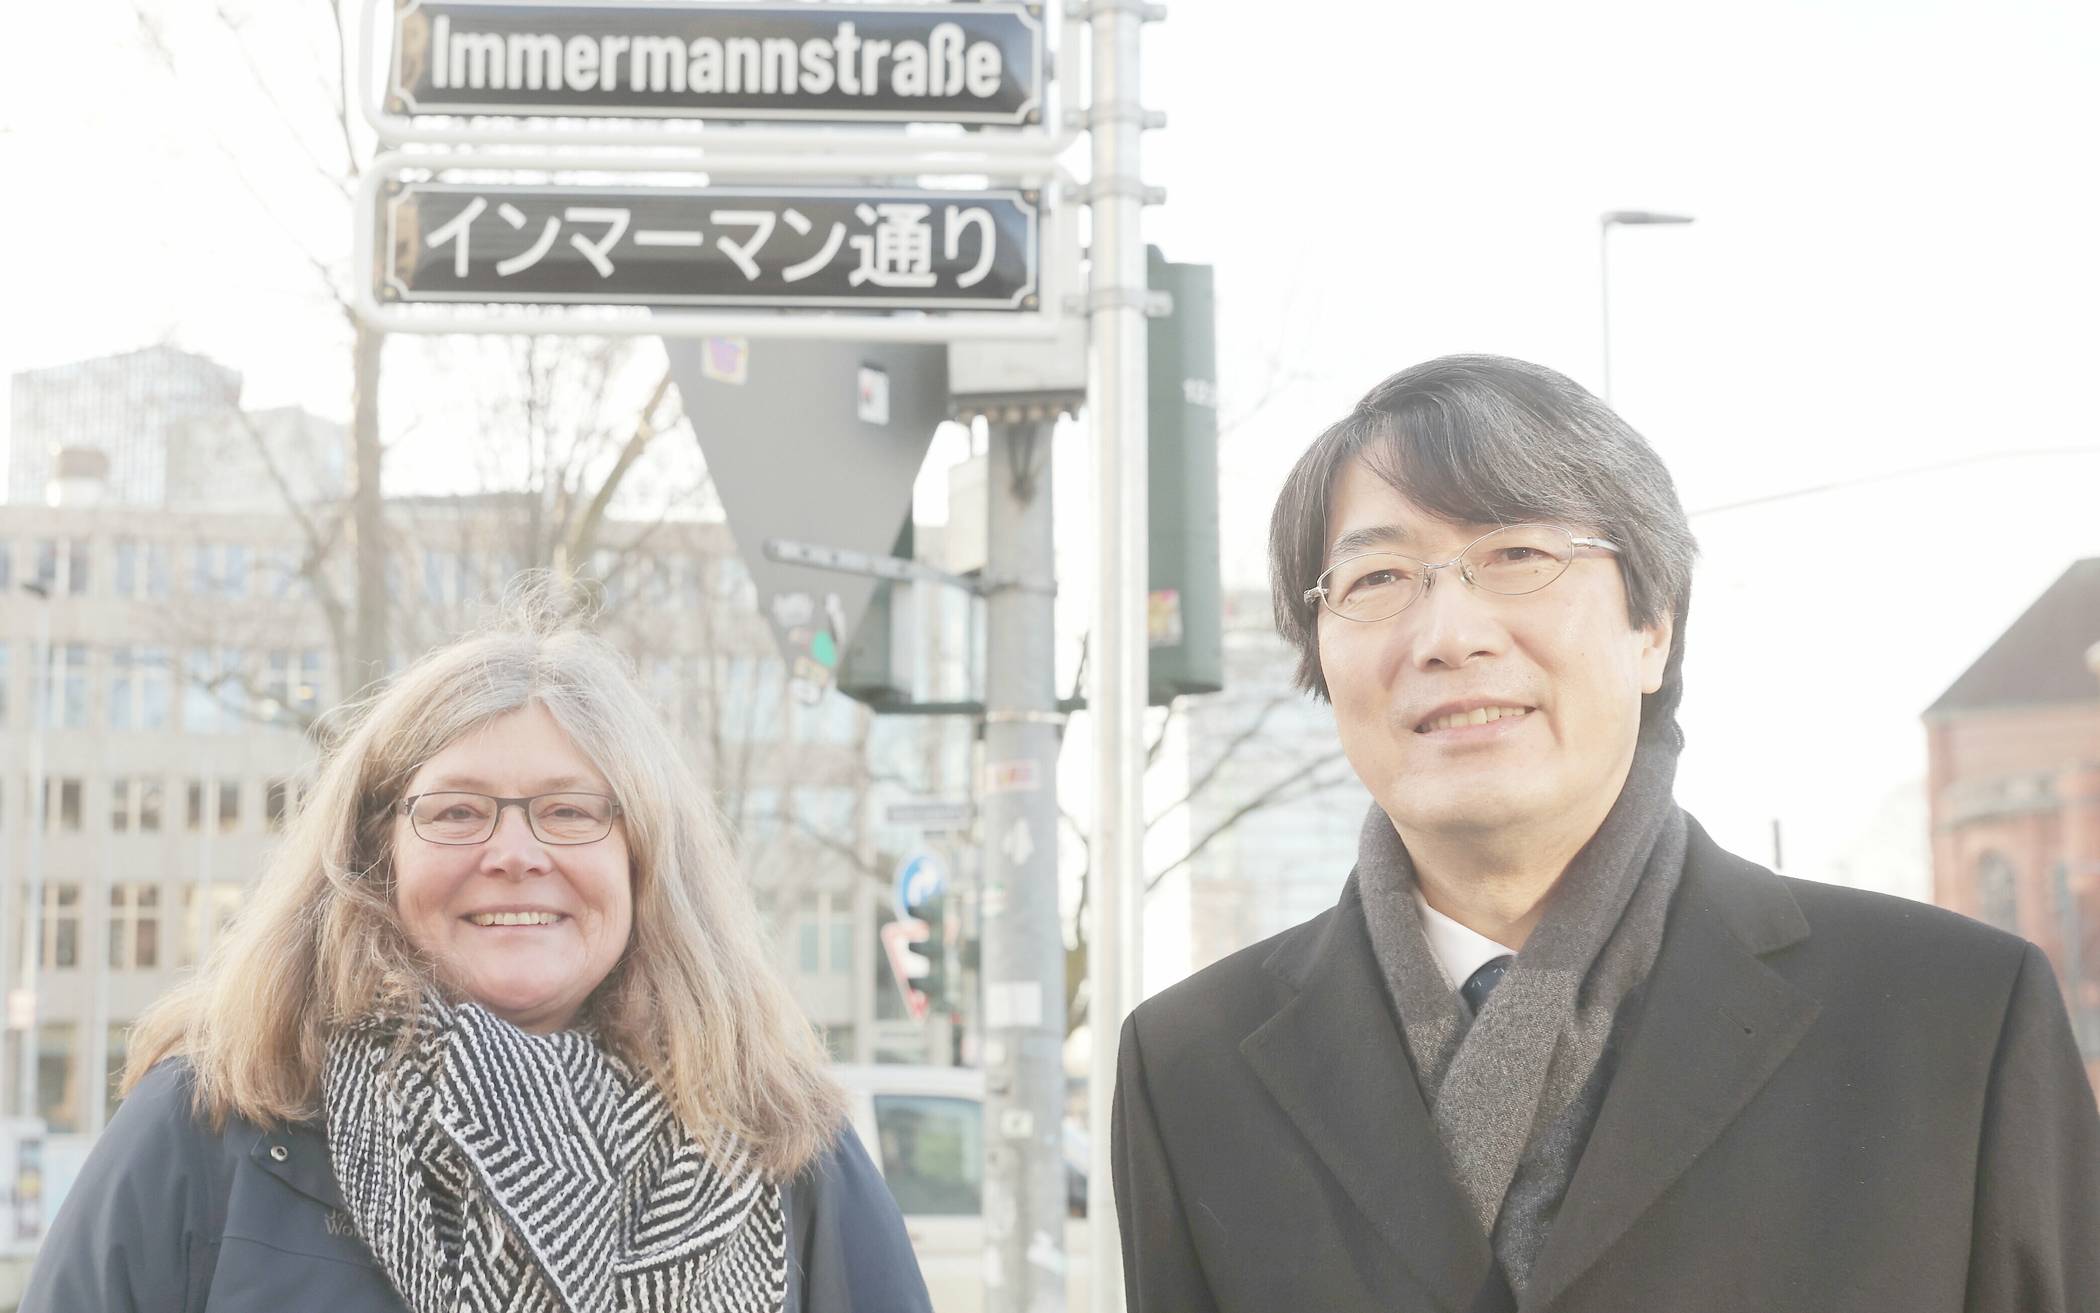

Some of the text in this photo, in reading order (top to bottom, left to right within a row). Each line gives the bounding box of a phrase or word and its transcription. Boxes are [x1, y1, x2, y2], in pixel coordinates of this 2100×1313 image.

[432, 14, 1001, 98] Immermannstraße
[425, 195, 996, 289] インマーマン通り
